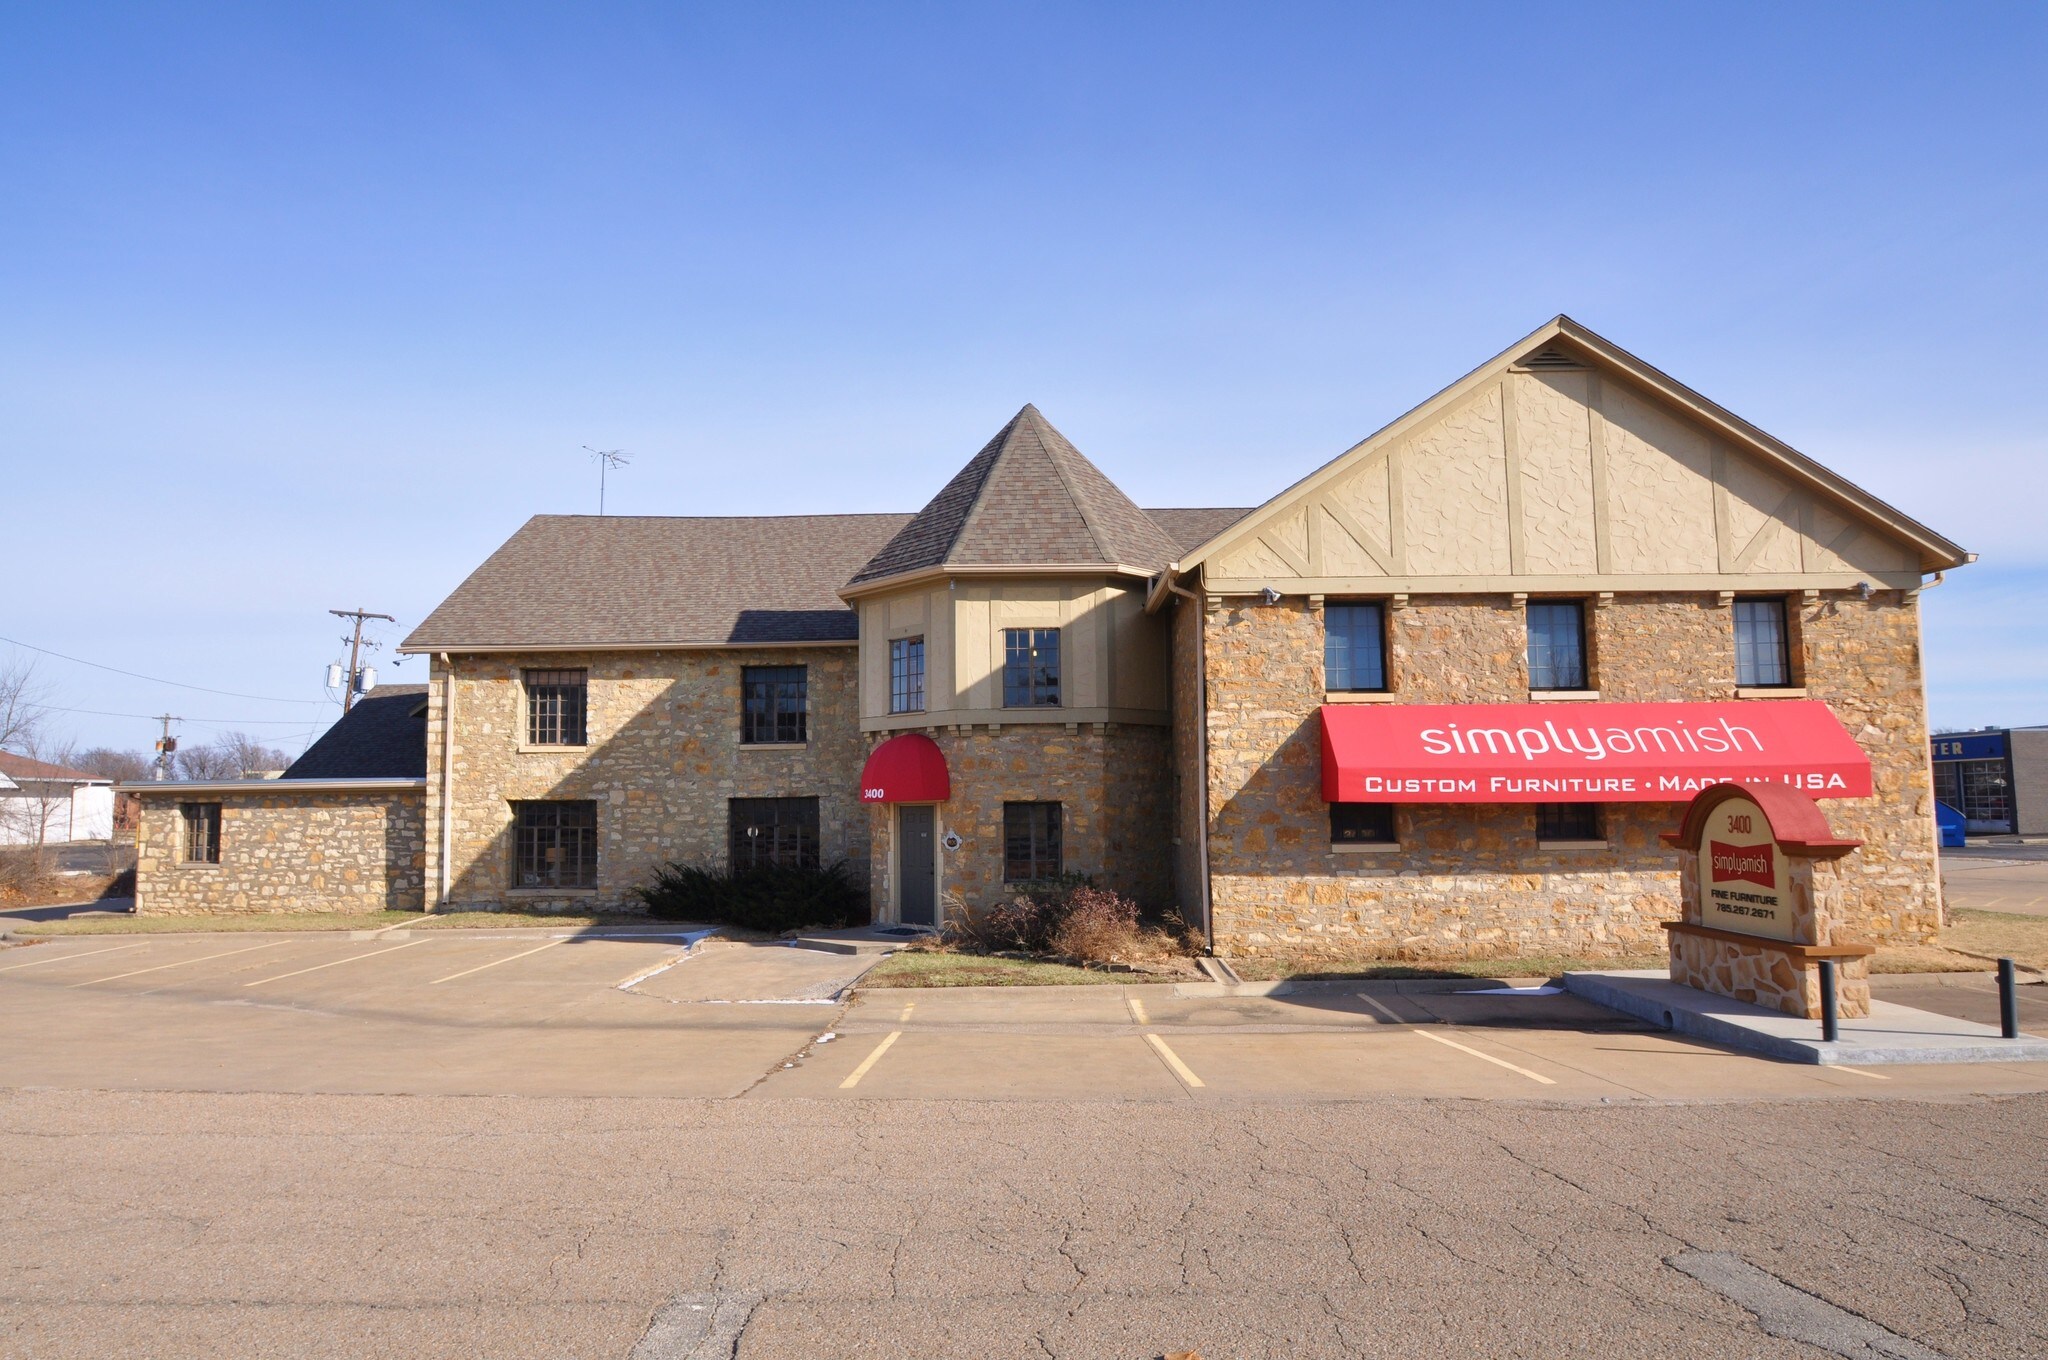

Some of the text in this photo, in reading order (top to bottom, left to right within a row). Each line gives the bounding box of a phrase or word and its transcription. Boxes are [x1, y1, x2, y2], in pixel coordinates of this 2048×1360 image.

[1420, 718, 1764, 761] simplyamish
[1365, 776, 1476, 792] CUSTOM
[1490, 776, 1637, 792] FURNITURE
[864, 788, 884, 799] 3400
[1727, 815, 1752, 834] 3400
[1713, 852, 1768, 875] simplyamish
[1711, 889, 1778, 906] FINE FURNITURE
[1715, 902, 1775, 919] 785.267.2671
